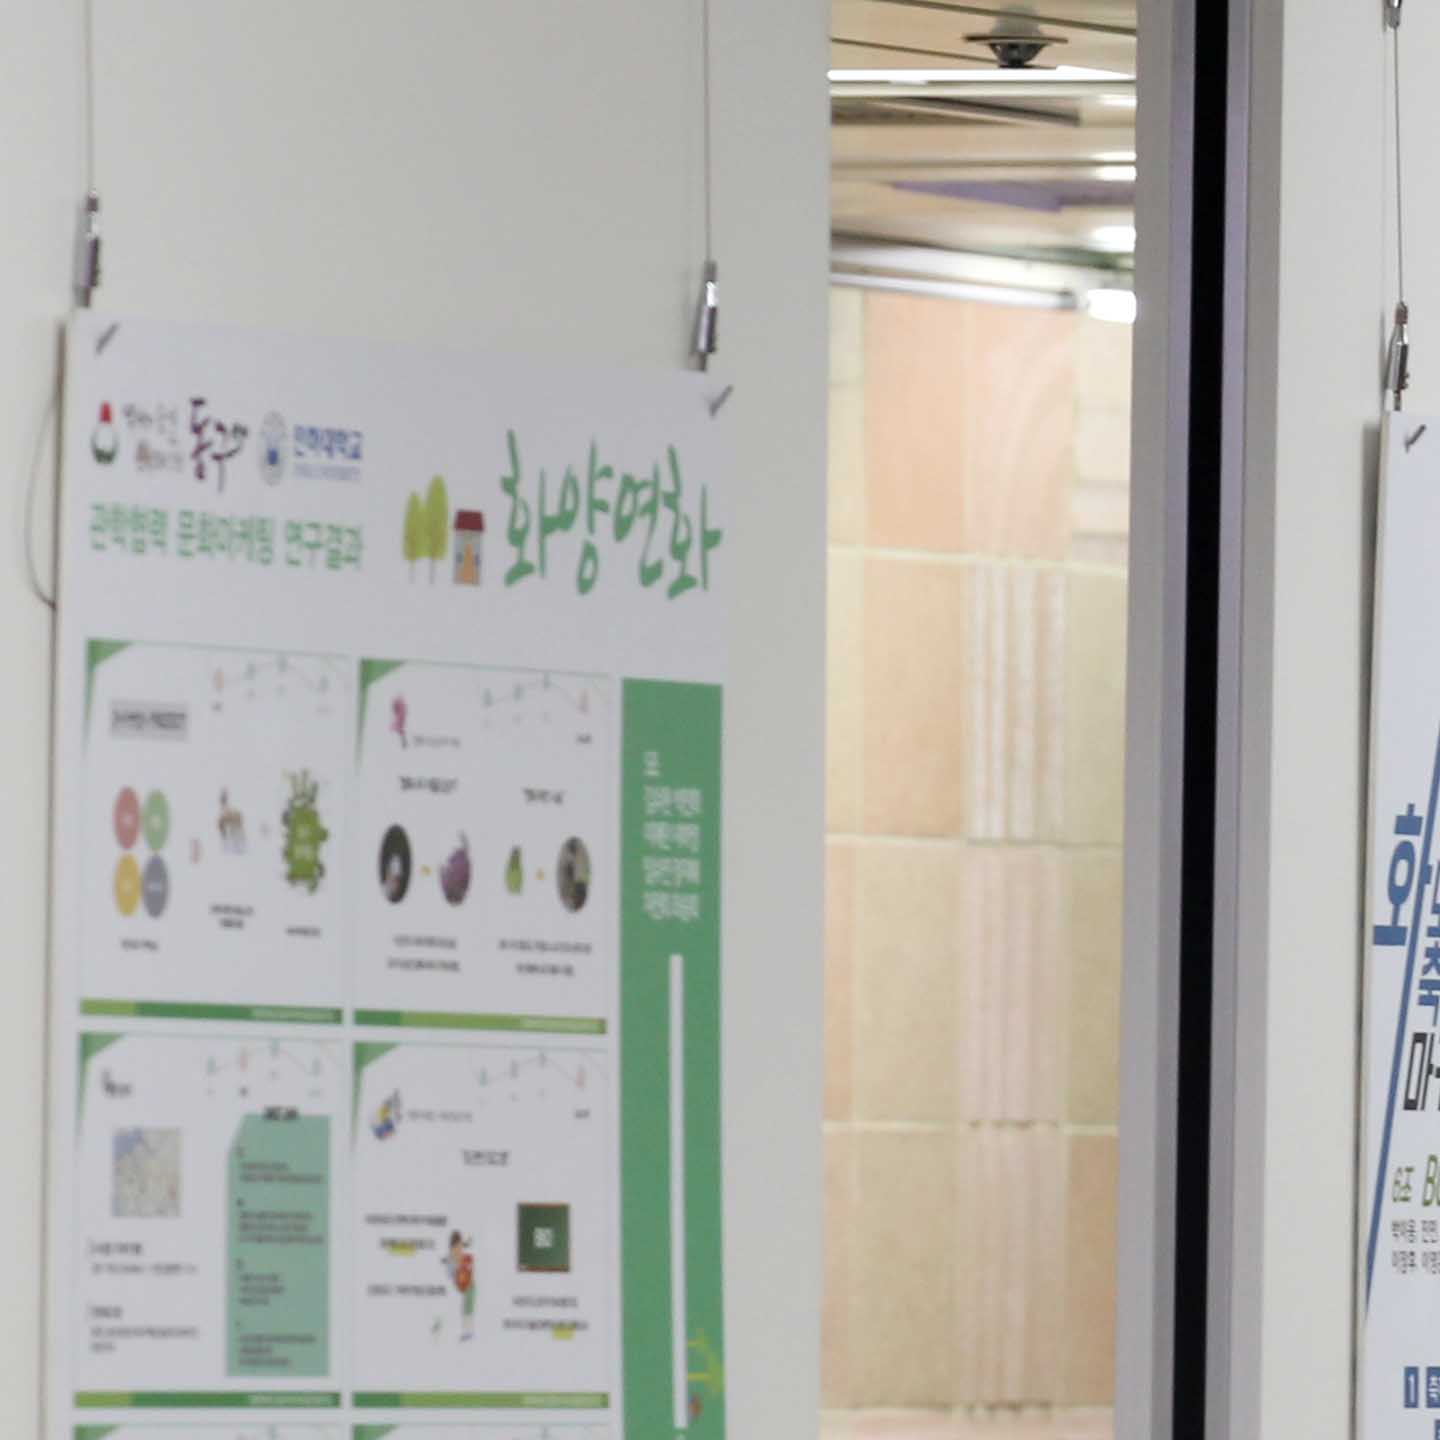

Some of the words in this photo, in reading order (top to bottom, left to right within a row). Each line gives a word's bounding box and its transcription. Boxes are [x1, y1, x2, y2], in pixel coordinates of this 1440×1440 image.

[502, 428, 723, 600] 화양연화
[178, 509, 275, 568] 문화마케팅
[285, 515, 363, 570] 연구결과
[1391, 1166, 1414, 1203] 6조
[1408, 1374, 1414, 1403] 1
